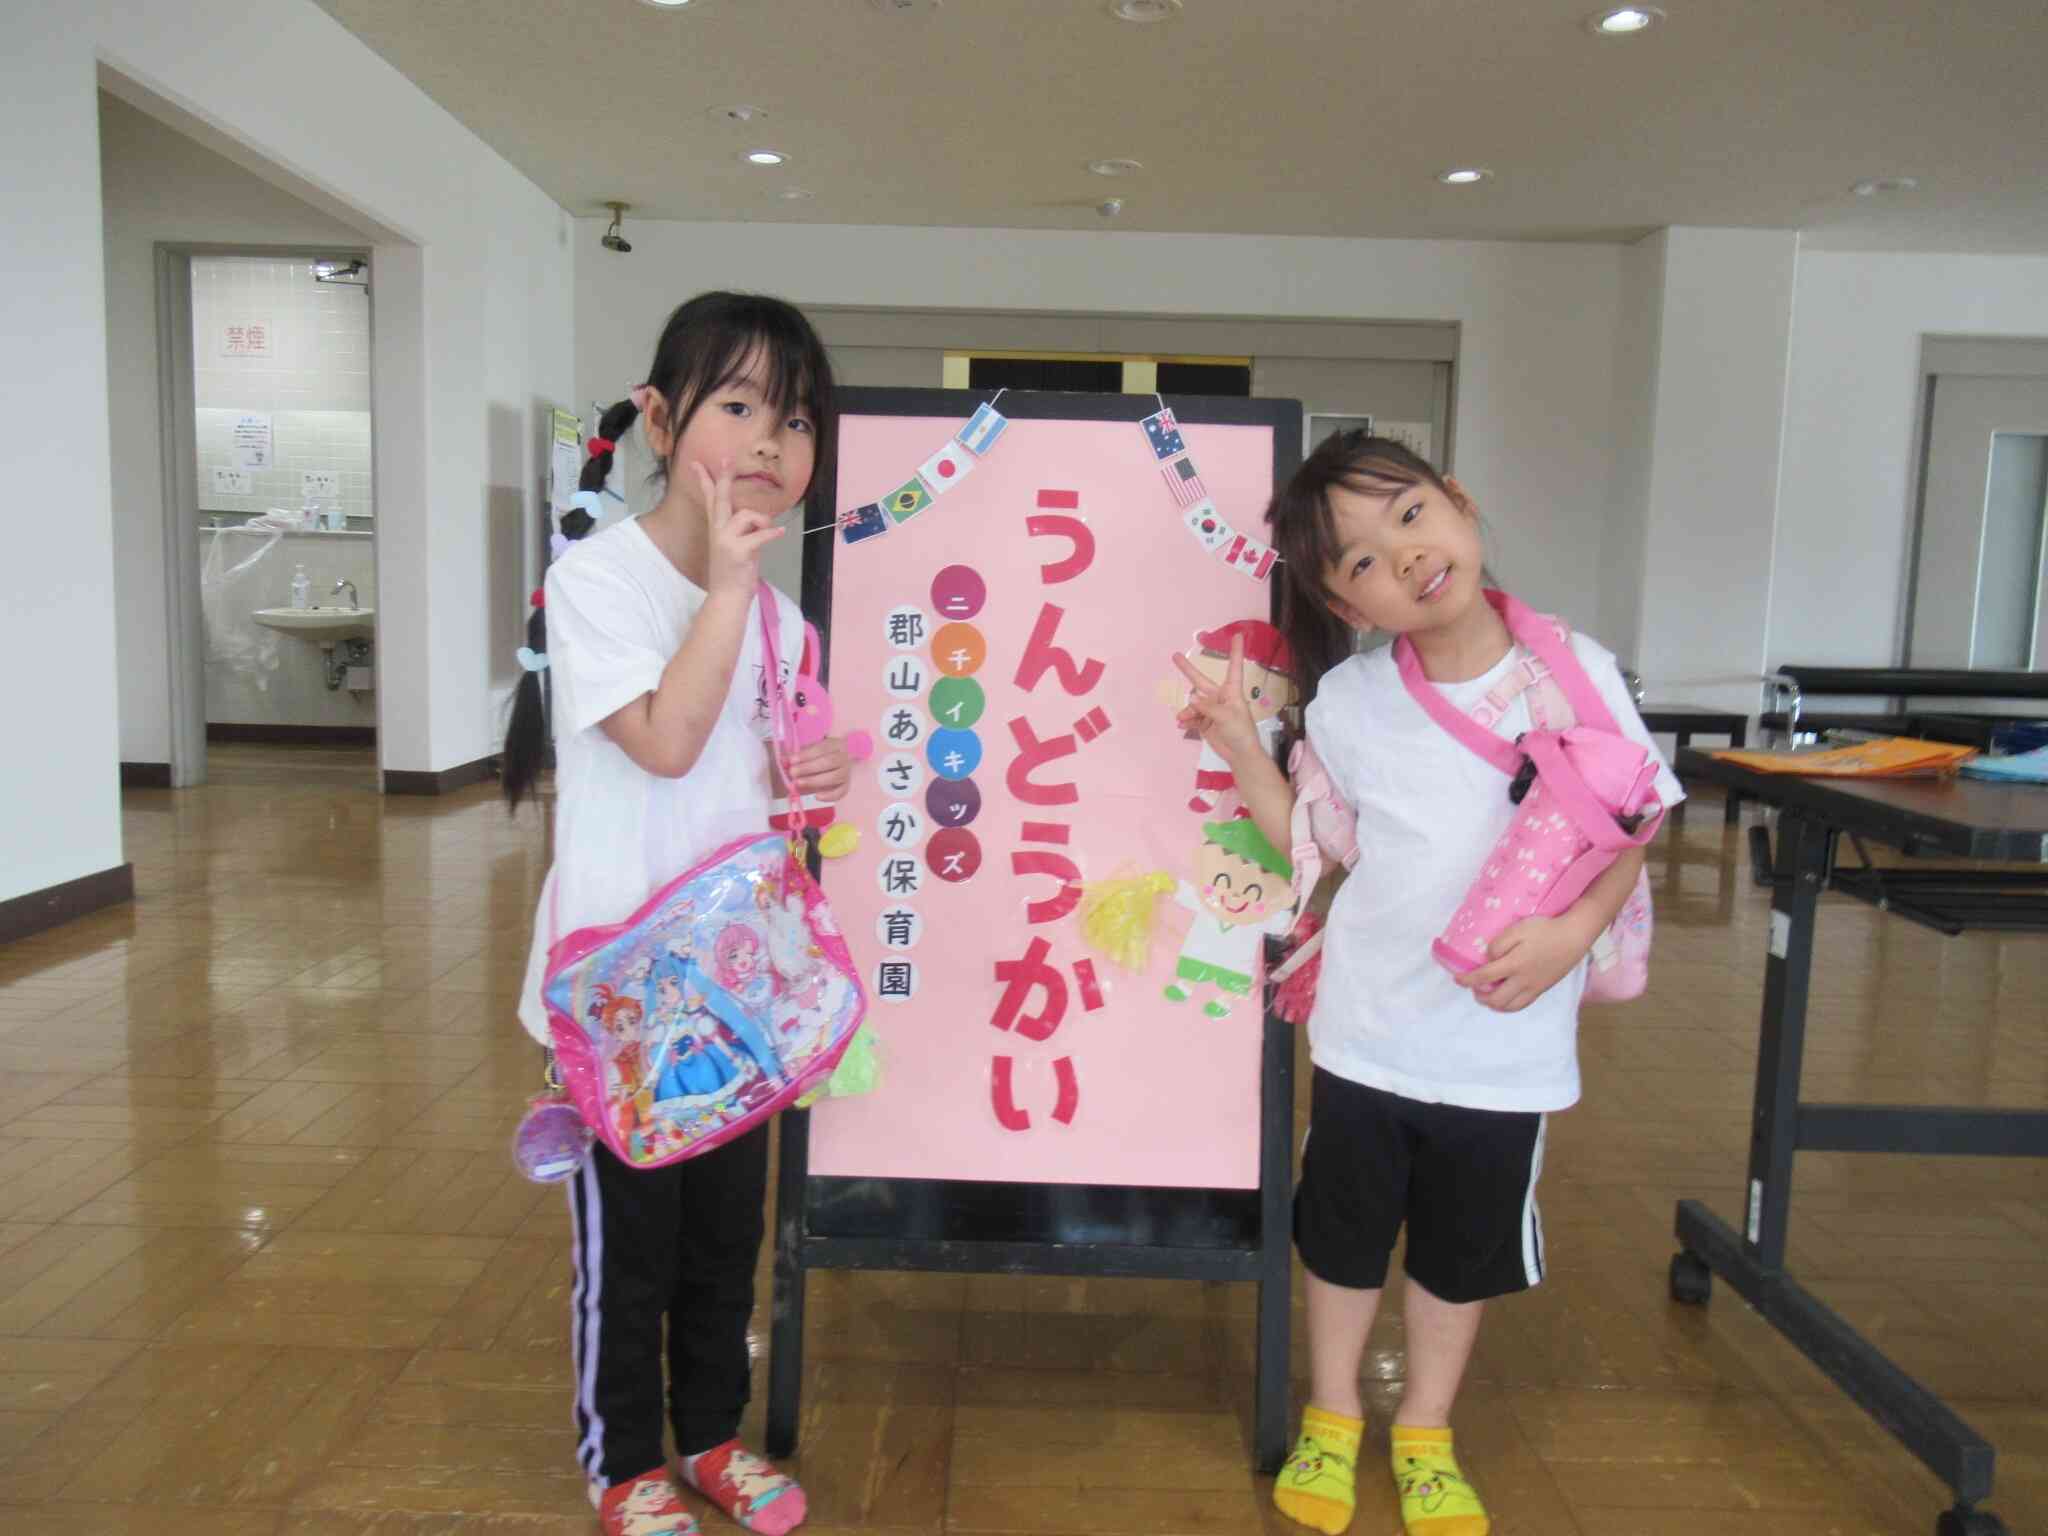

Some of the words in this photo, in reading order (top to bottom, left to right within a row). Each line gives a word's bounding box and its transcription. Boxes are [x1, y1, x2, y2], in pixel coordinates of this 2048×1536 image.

[878, 613, 924, 997] 郡山あさか保育園
[940, 595, 974, 878] ニチイキッズ
[990, 488, 1112, 1131] うんどうかい
